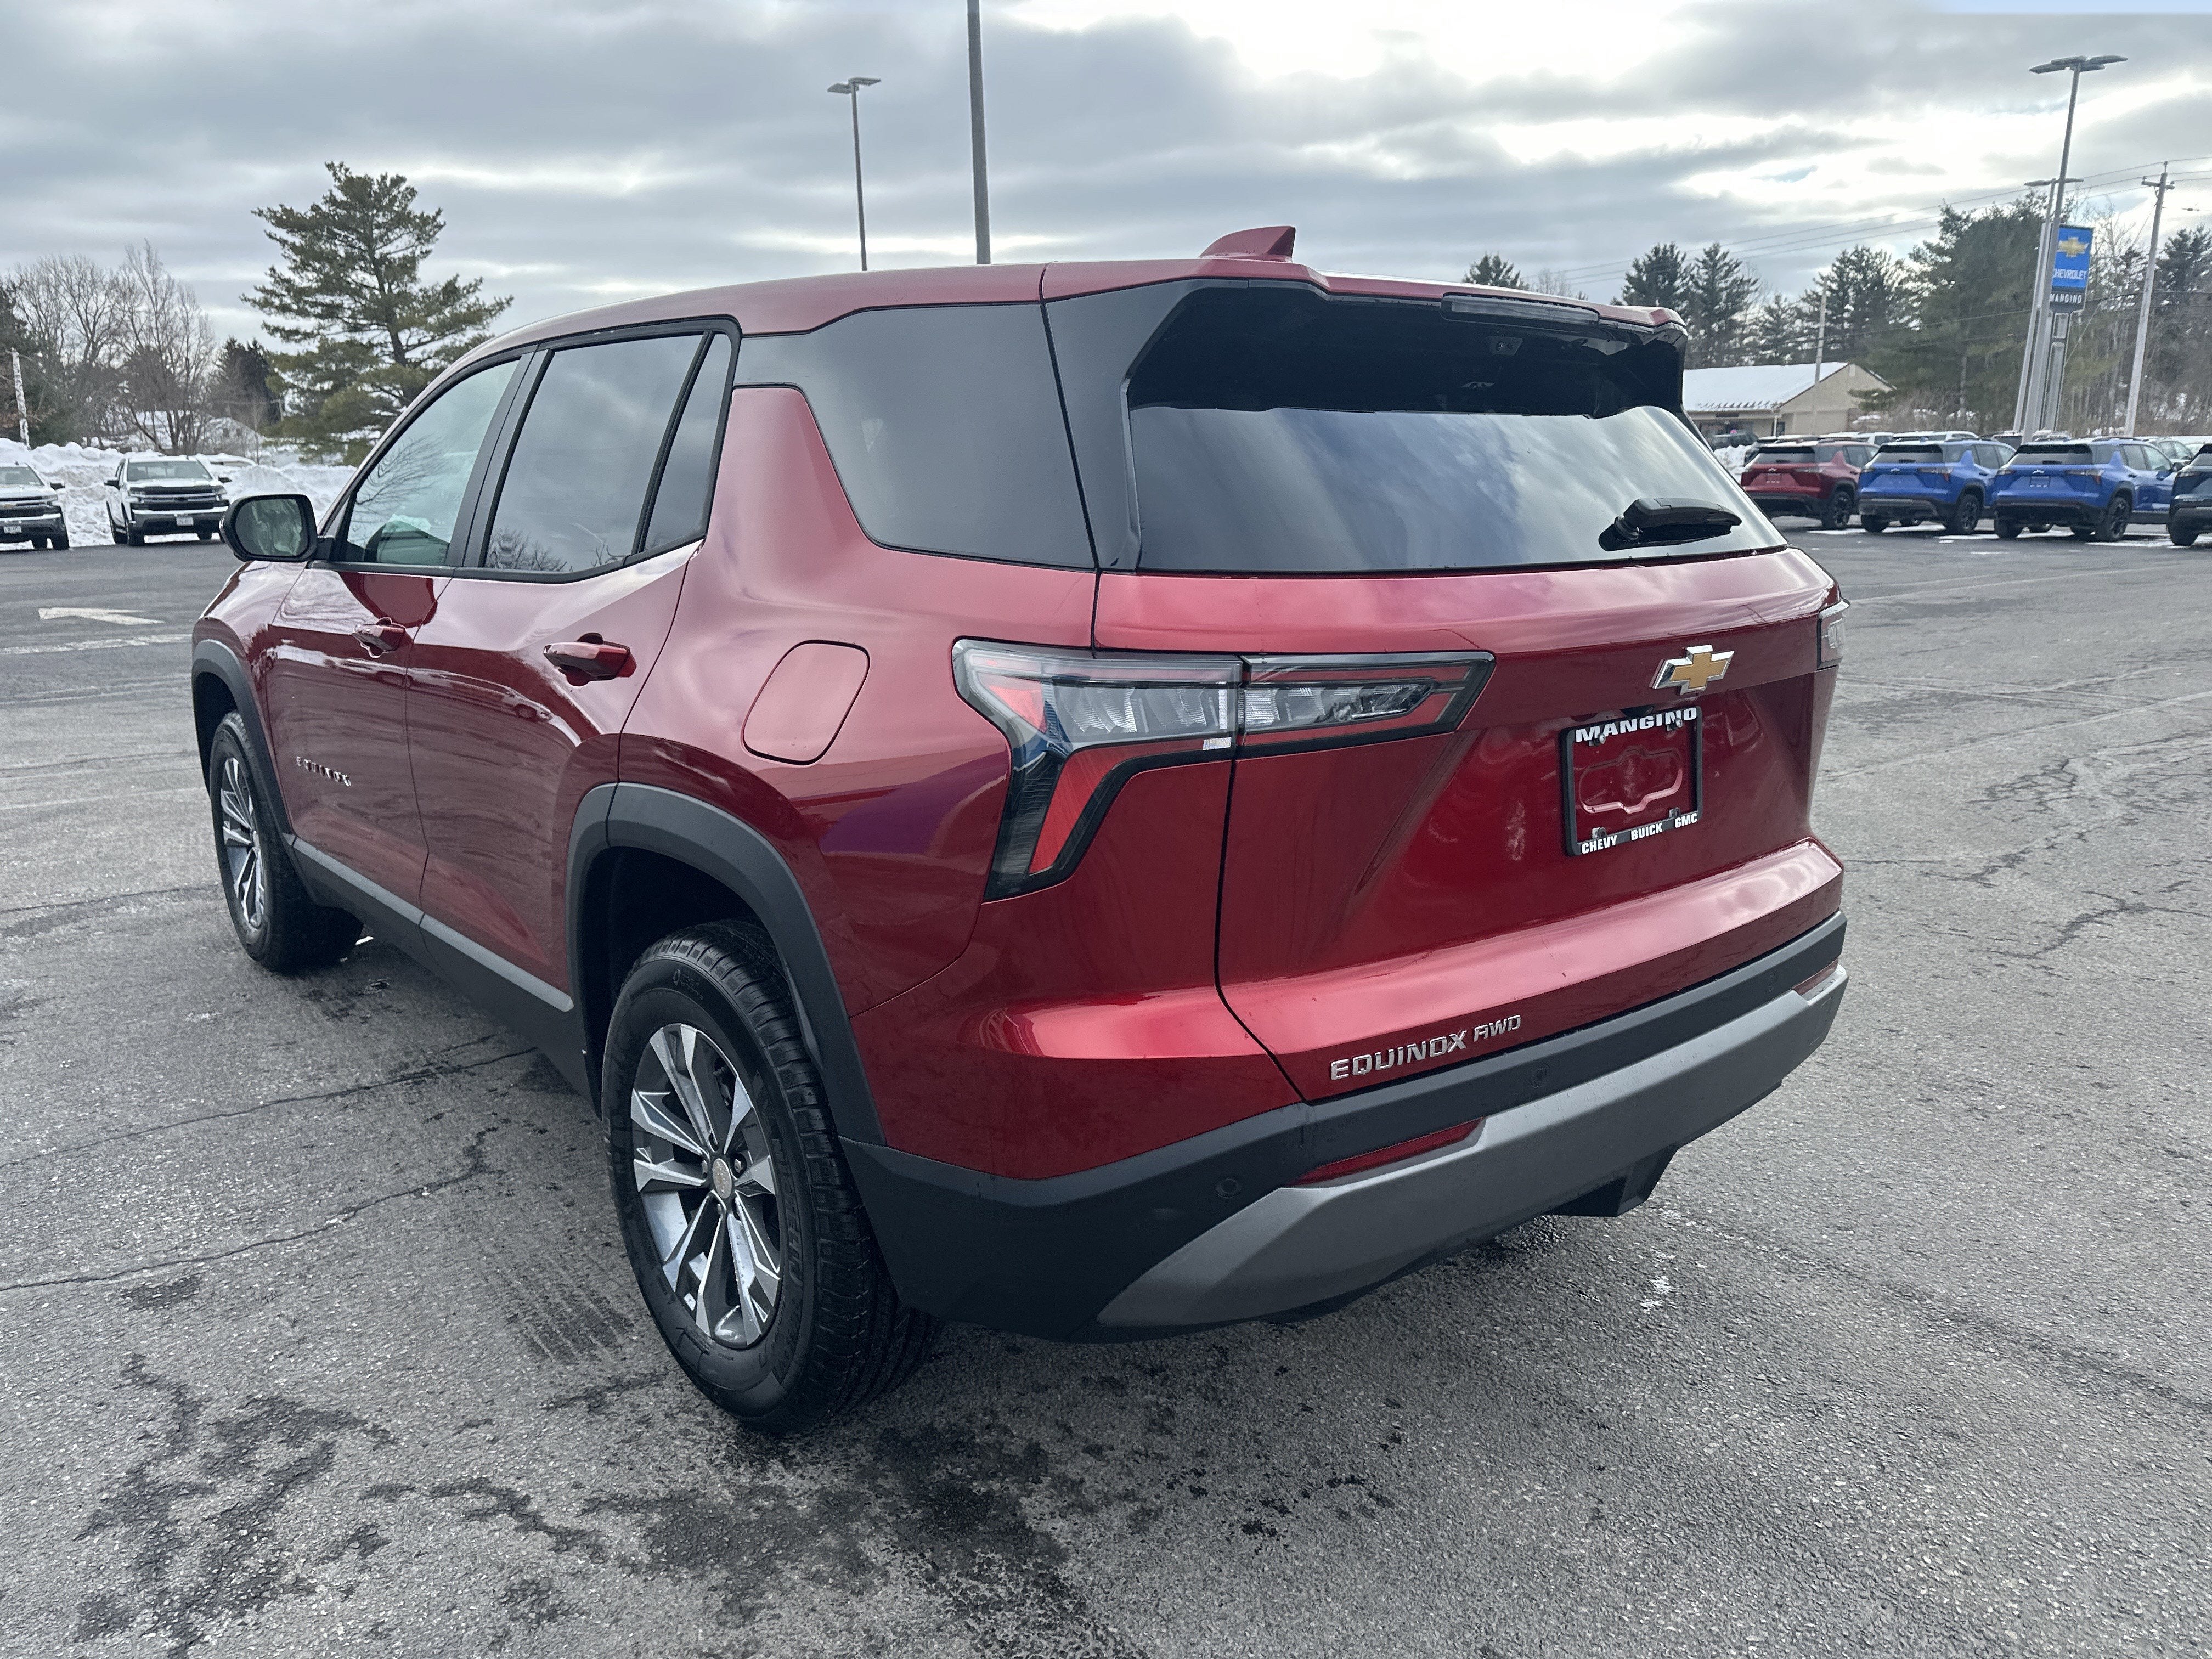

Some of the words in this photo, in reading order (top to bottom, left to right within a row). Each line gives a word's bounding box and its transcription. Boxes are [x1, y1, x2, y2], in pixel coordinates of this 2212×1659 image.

[2049, 293, 2082, 303] MANGINO
[1575, 707, 1697, 742] MANGINO
[1581, 835, 1618, 854] CHEVY
[1630, 822, 1663, 840] BUICK
[1674, 812, 1697, 828] GMC
[1330, 1030, 1467, 1080] EQUINOX
[1474, 1014, 1521, 1042] AWD
